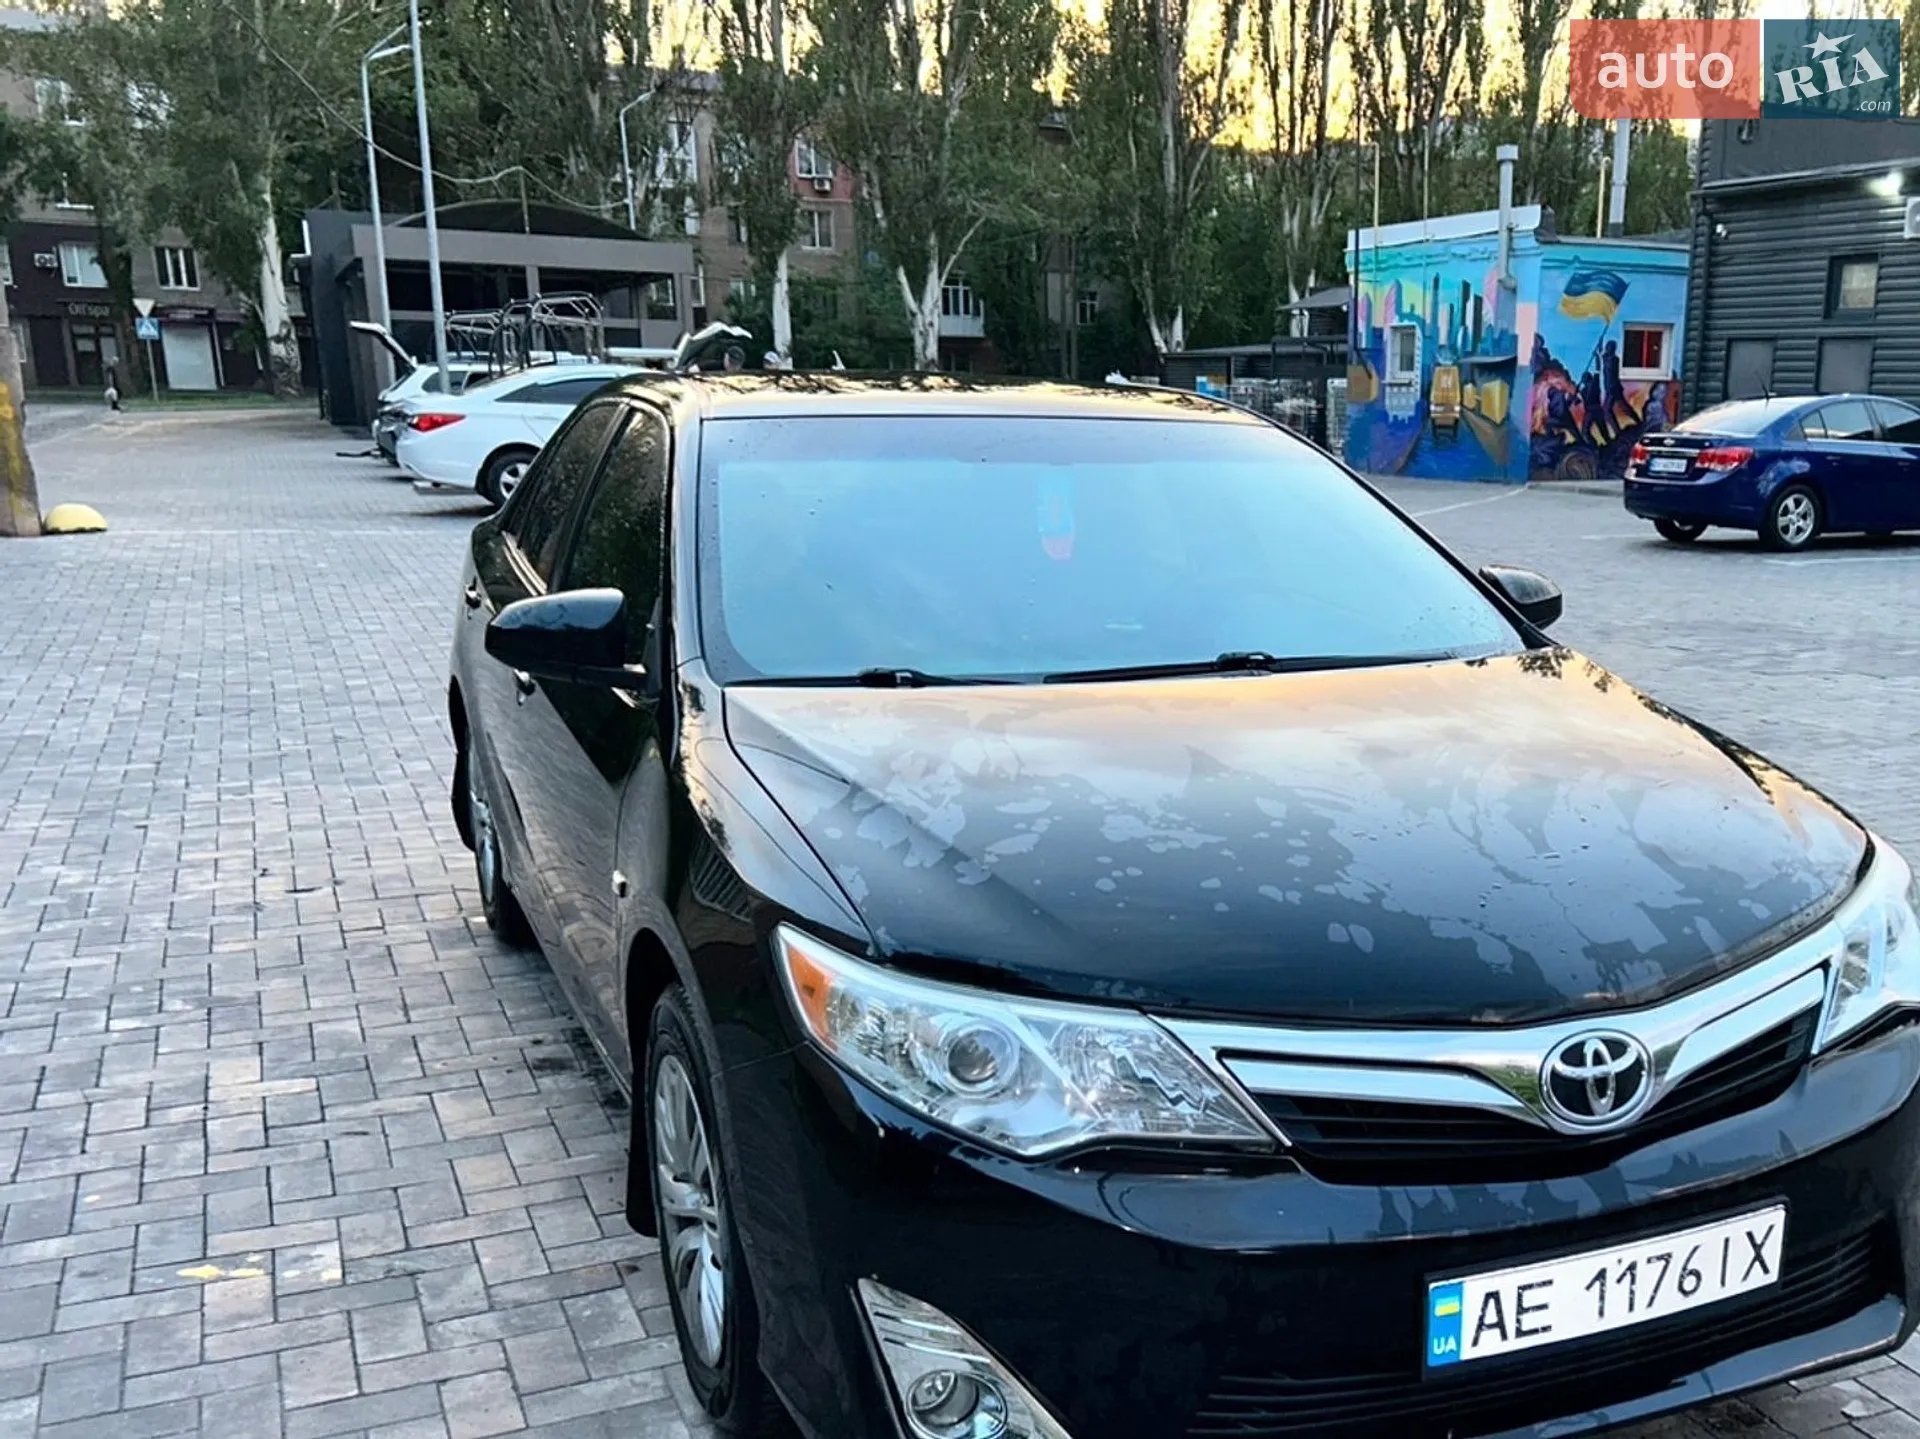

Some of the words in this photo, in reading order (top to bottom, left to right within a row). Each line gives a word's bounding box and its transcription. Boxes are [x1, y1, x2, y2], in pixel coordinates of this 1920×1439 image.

[1471, 1278, 1554, 1348] AE
[1584, 1244, 1702, 1319] 1176
[1719, 1223, 1775, 1288] IX
[1433, 1337, 1457, 1355] UA
